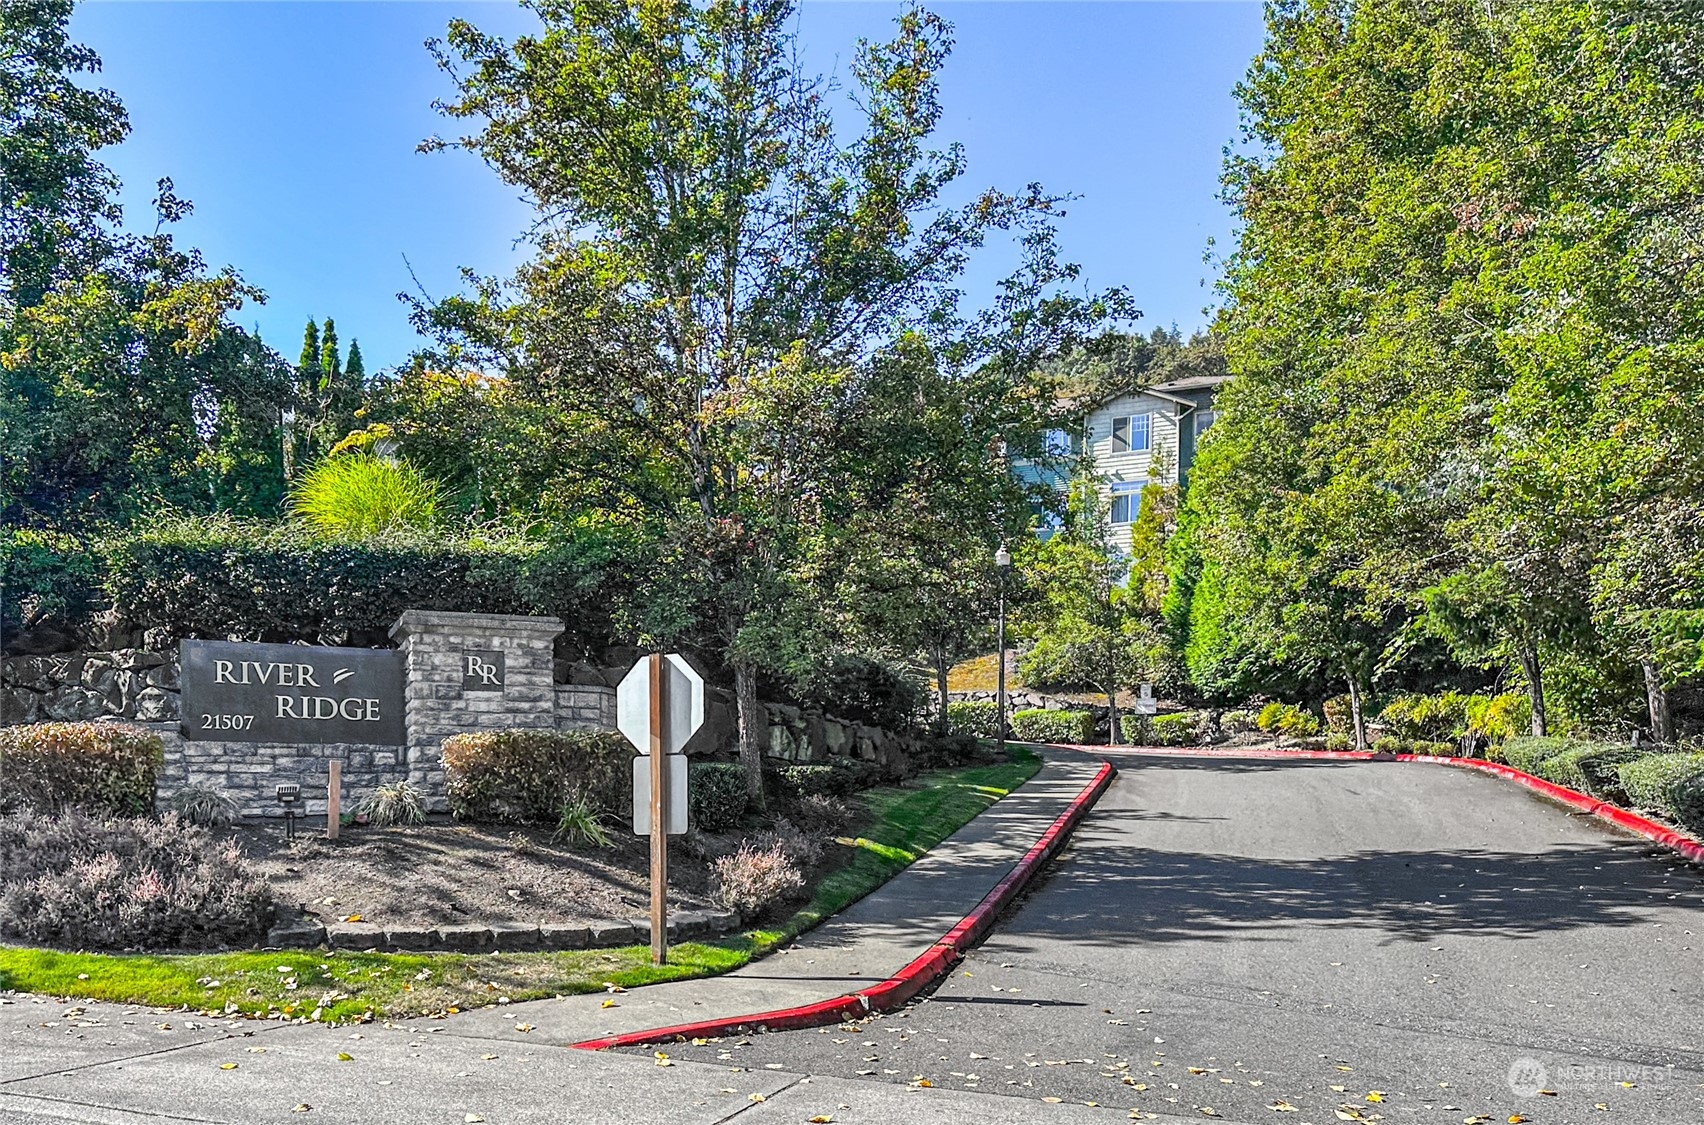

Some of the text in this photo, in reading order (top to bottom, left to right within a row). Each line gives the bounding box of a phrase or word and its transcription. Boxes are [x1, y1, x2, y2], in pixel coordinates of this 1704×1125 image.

[213, 659, 320, 687] RIVER
[464, 655, 502, 685] RR
[275, 695, 381, 721] RIDGE
[201, 714, 254, 730] 21507
